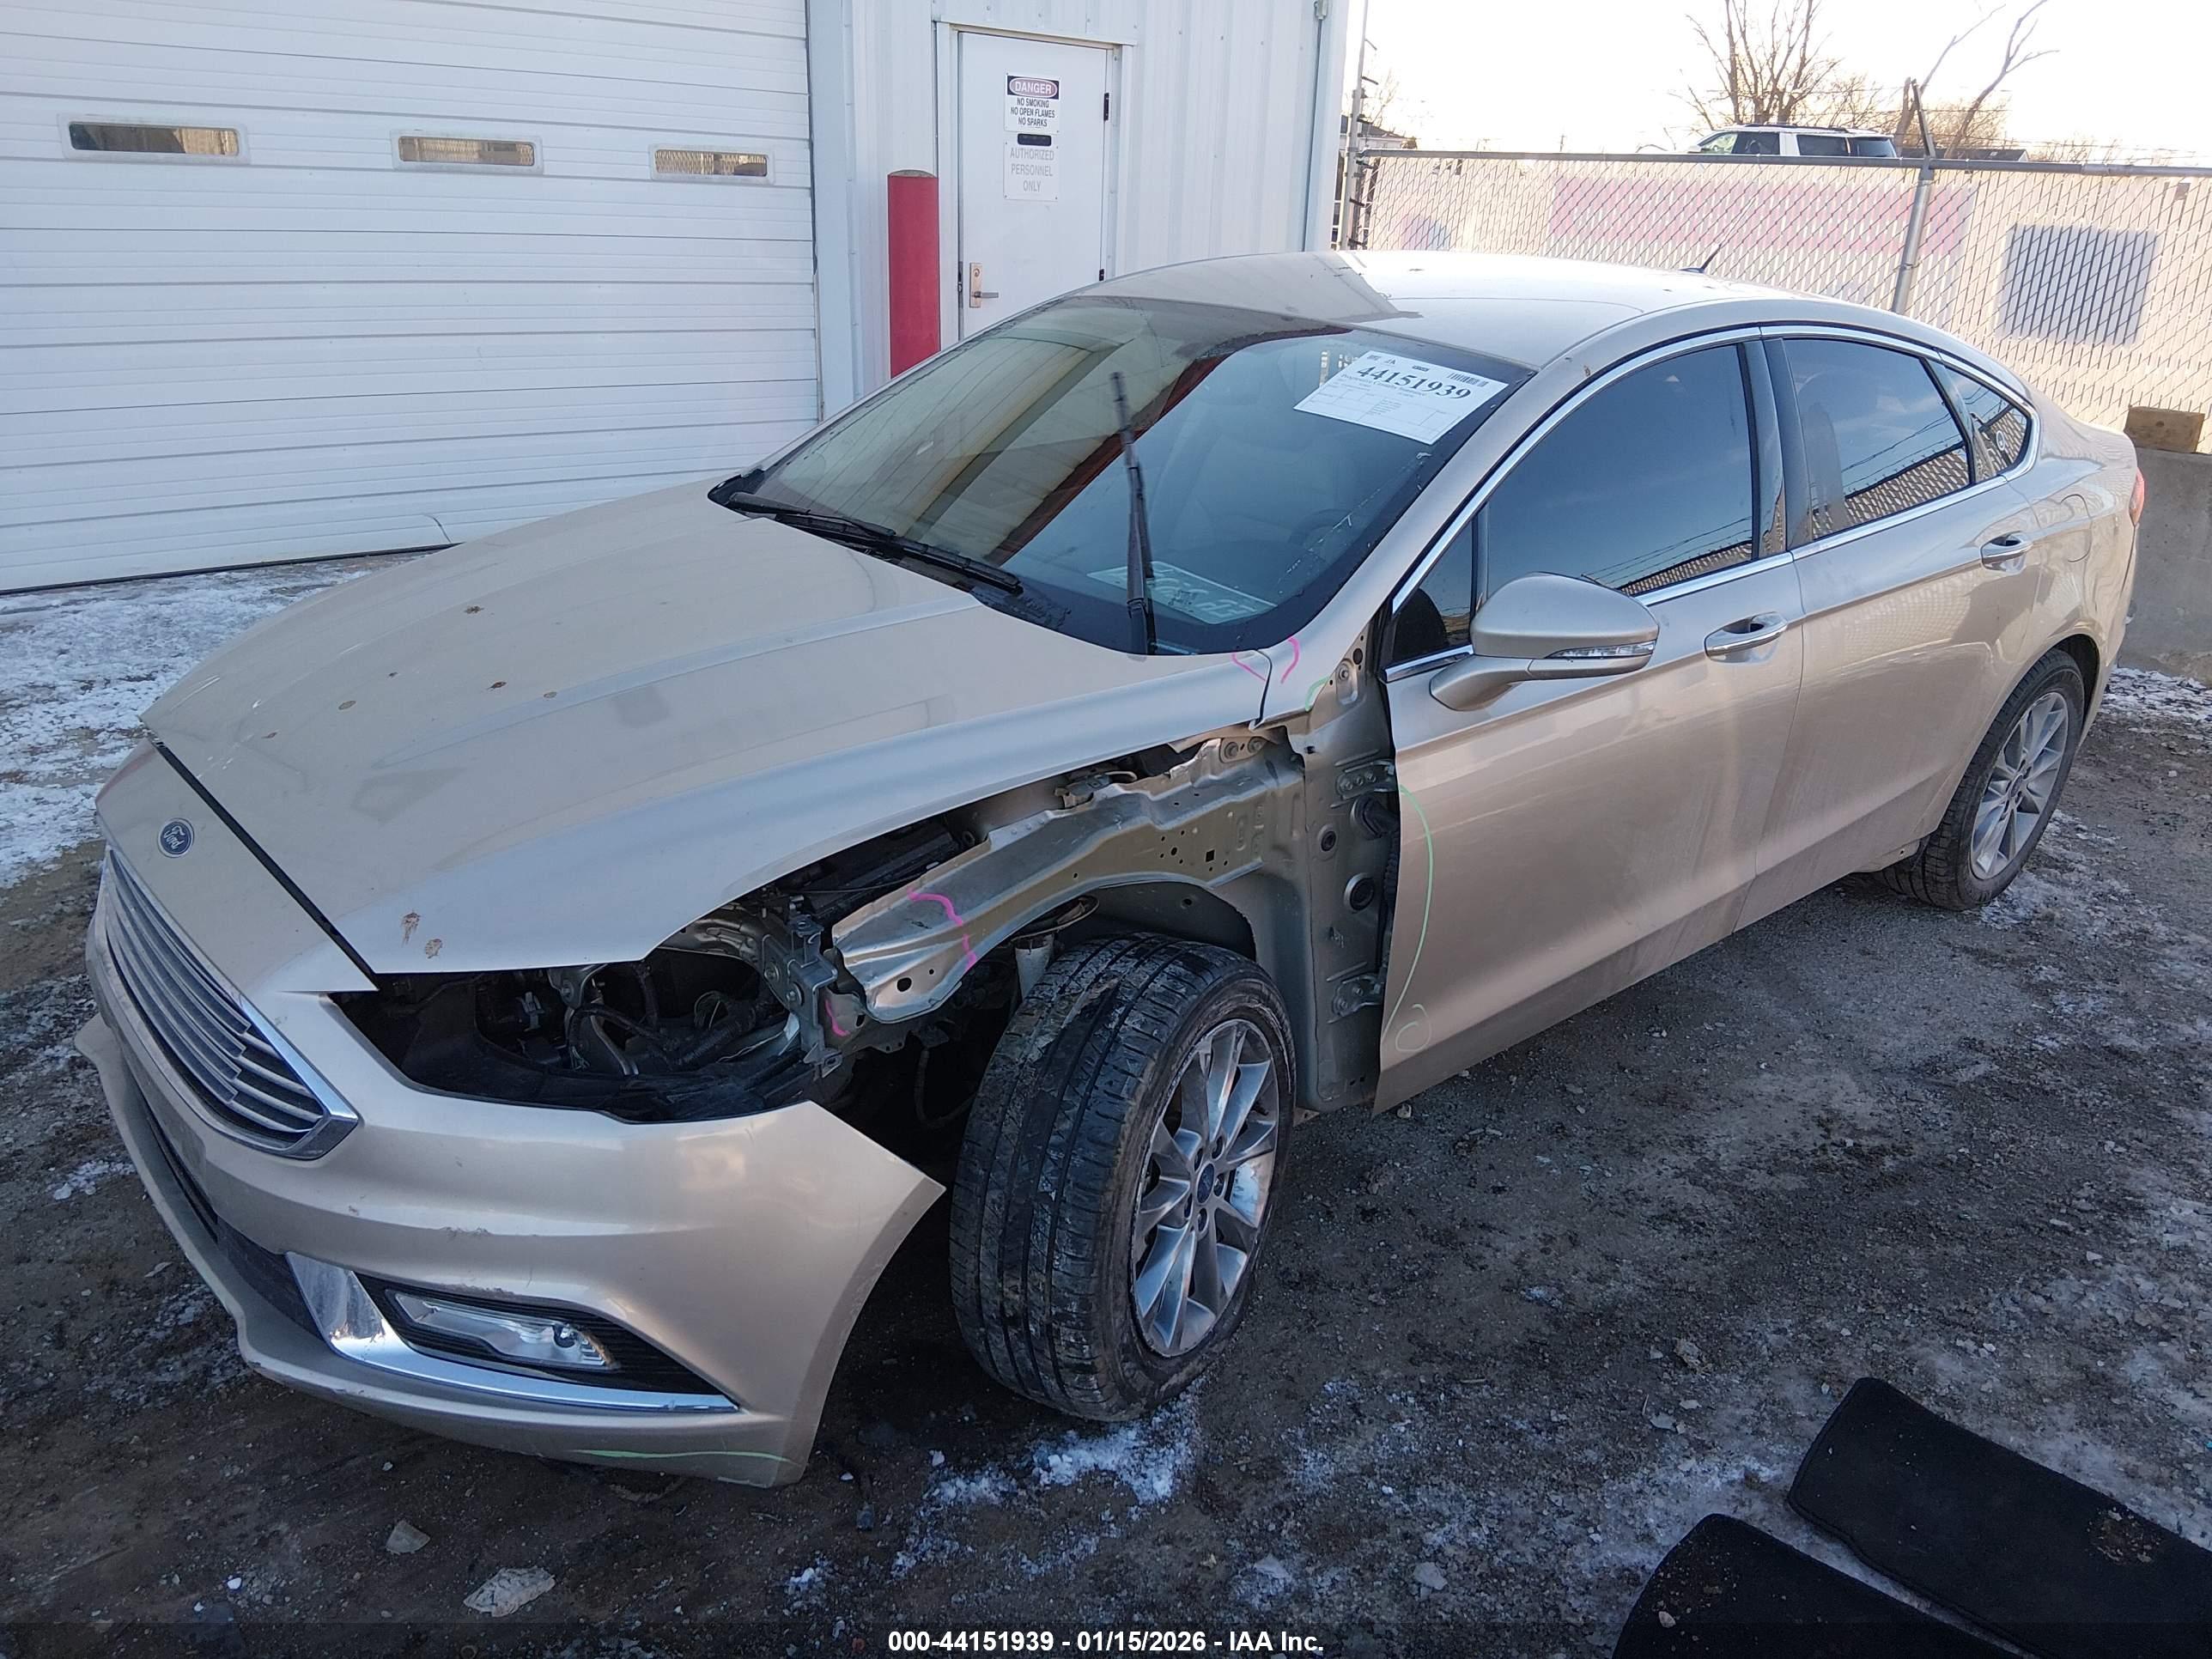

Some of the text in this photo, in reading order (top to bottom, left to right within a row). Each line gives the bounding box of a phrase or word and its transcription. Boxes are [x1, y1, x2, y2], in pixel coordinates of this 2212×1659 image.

[1015, 81, 1052, 94] DANGER
[1017, 97, 1049, 108] NO SMOKING
[1010, 106, 1055, 118] NO OPEN FLAMES
[1018, 117, 1048, 127] NO SPARKS
[1010, 148, 1054, 161] AUTHORIZED
[1011, 163, 1054, 177] PERSONNEL
[1023, 179, 1042, 193] ONLY
[1357, 366, 1471, 399] 44151939
